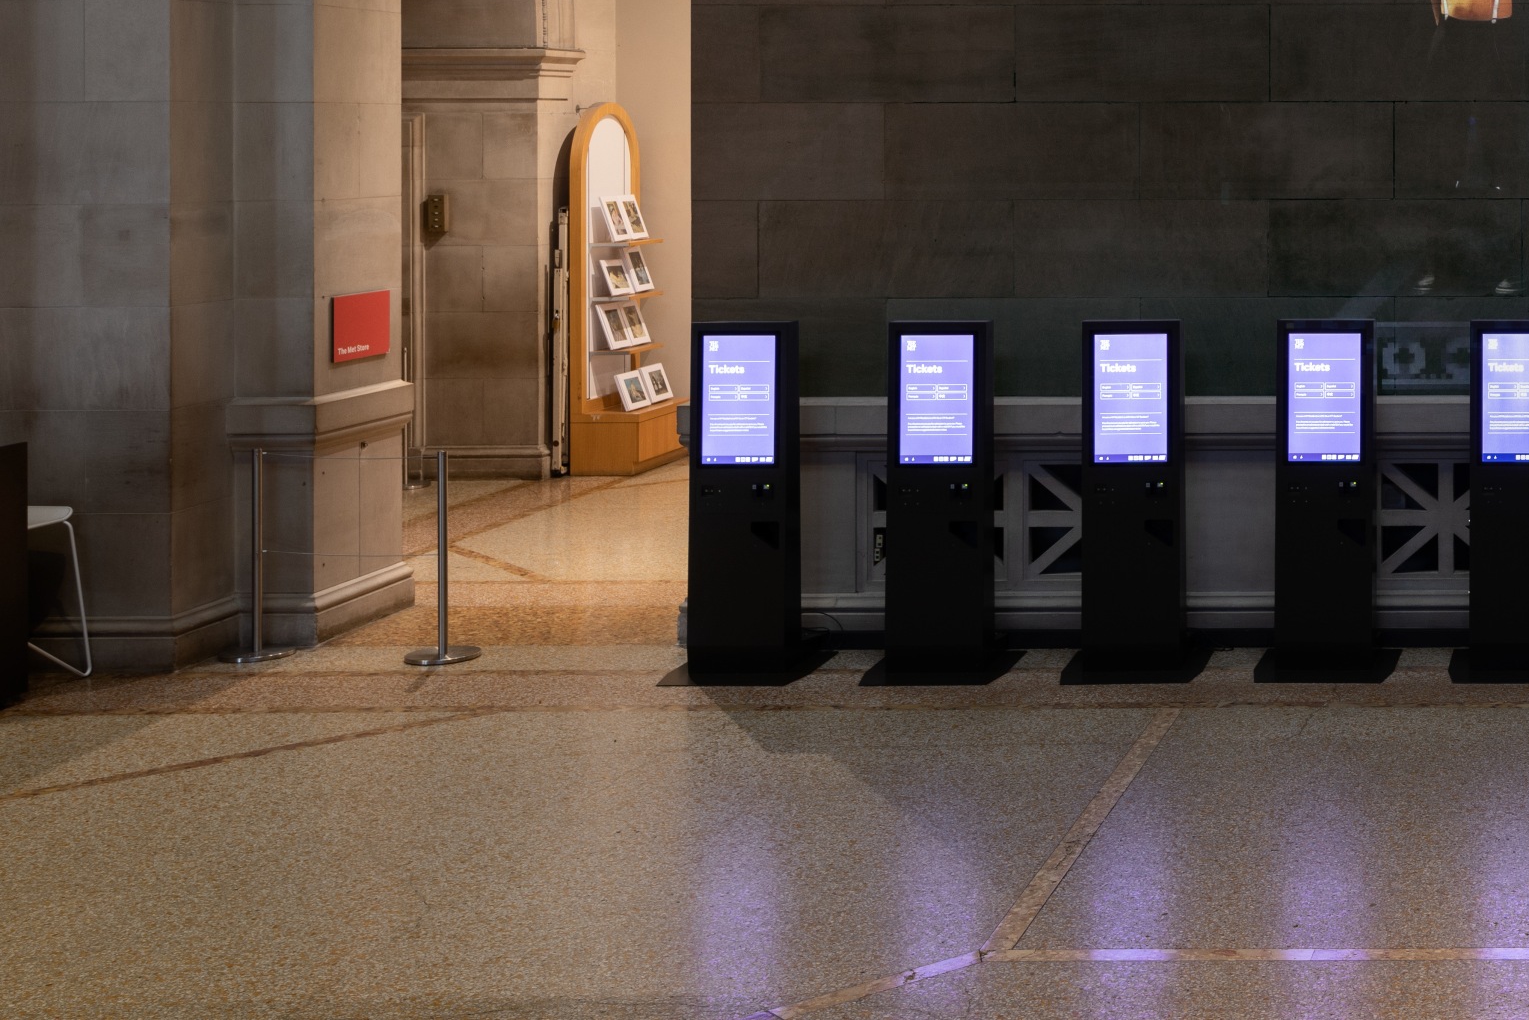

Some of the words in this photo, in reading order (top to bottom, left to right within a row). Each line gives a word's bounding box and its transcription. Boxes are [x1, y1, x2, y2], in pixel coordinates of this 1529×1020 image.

[337, 347, 347, 355] The
[357, 344, 369, 352] Store
[708, 364, 745, 374] Tickets
[906, 364, 943, 373] Tickets
[1099, 363, 1137, 372] Tickets
[1294, 362, 1330, 372] Tickets
[1487, 362, 1524, 372] Tickets
